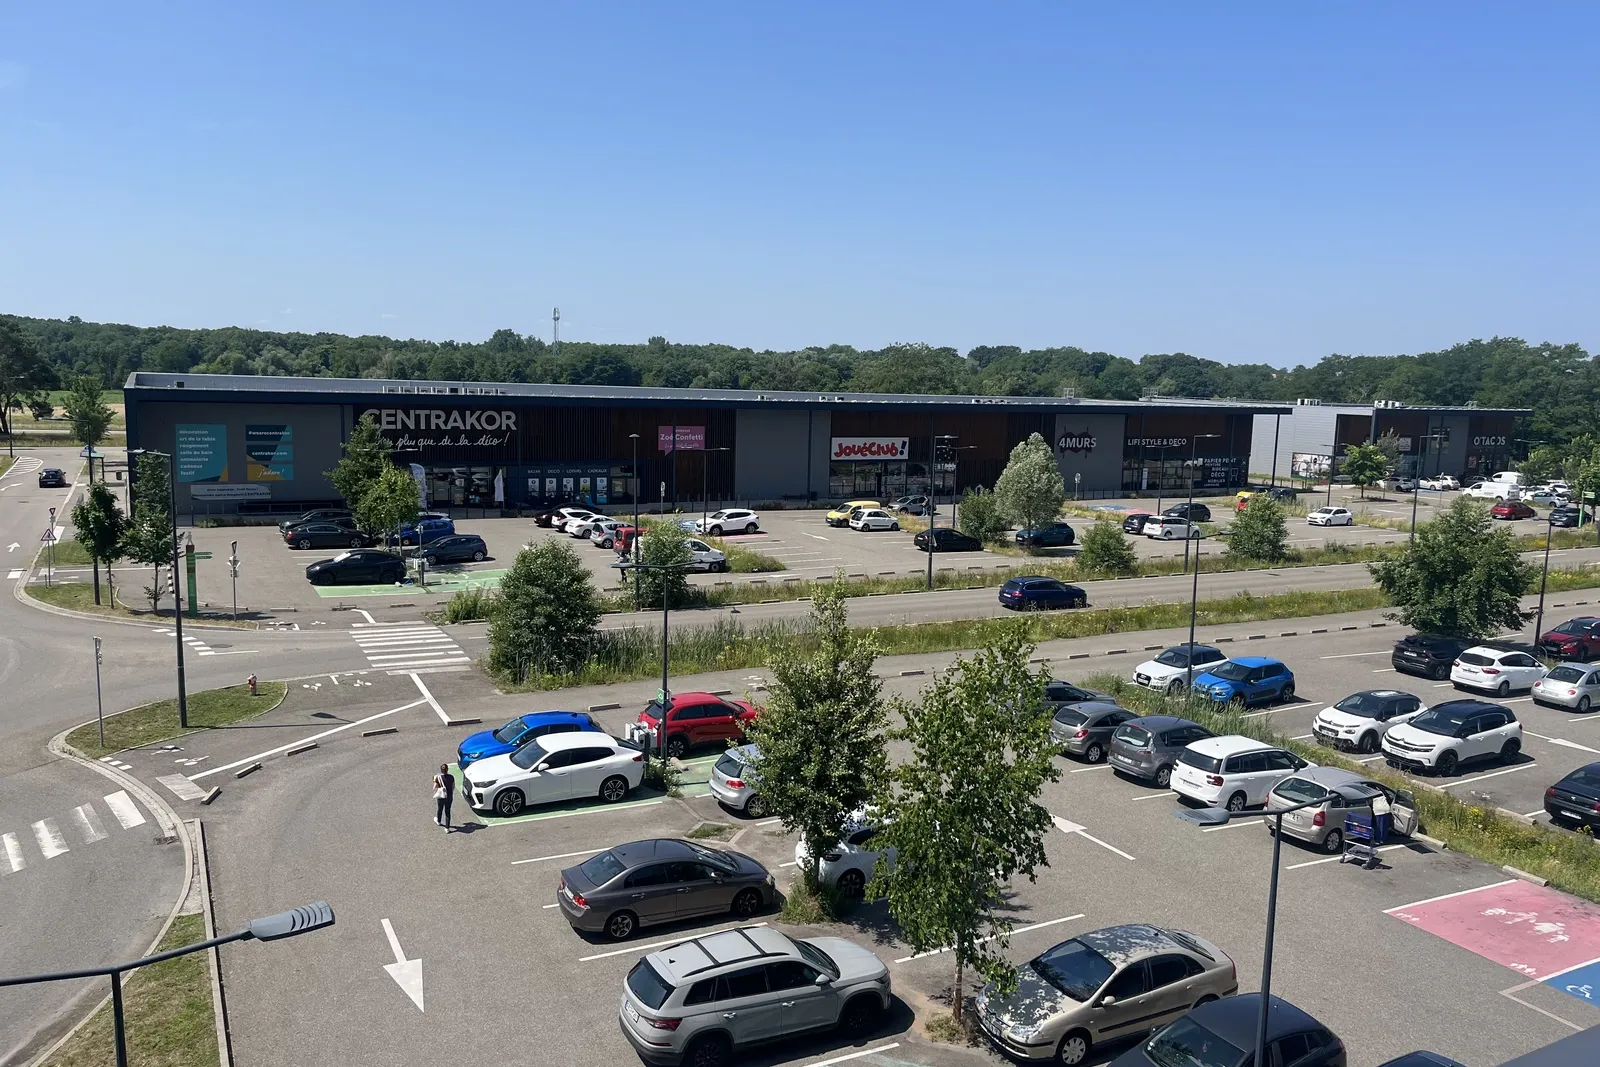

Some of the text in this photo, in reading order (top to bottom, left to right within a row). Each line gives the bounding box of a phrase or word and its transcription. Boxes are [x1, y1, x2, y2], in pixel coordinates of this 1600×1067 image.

[395, 433, 416, 451] plus
[417, 438, 437, 452] que
[438, 435, 453, 446] de
[454, 434, 472, 446] la
[675, 433, 704, 441] Confetti
[1058, 437, 1097, 449] 4MURS
